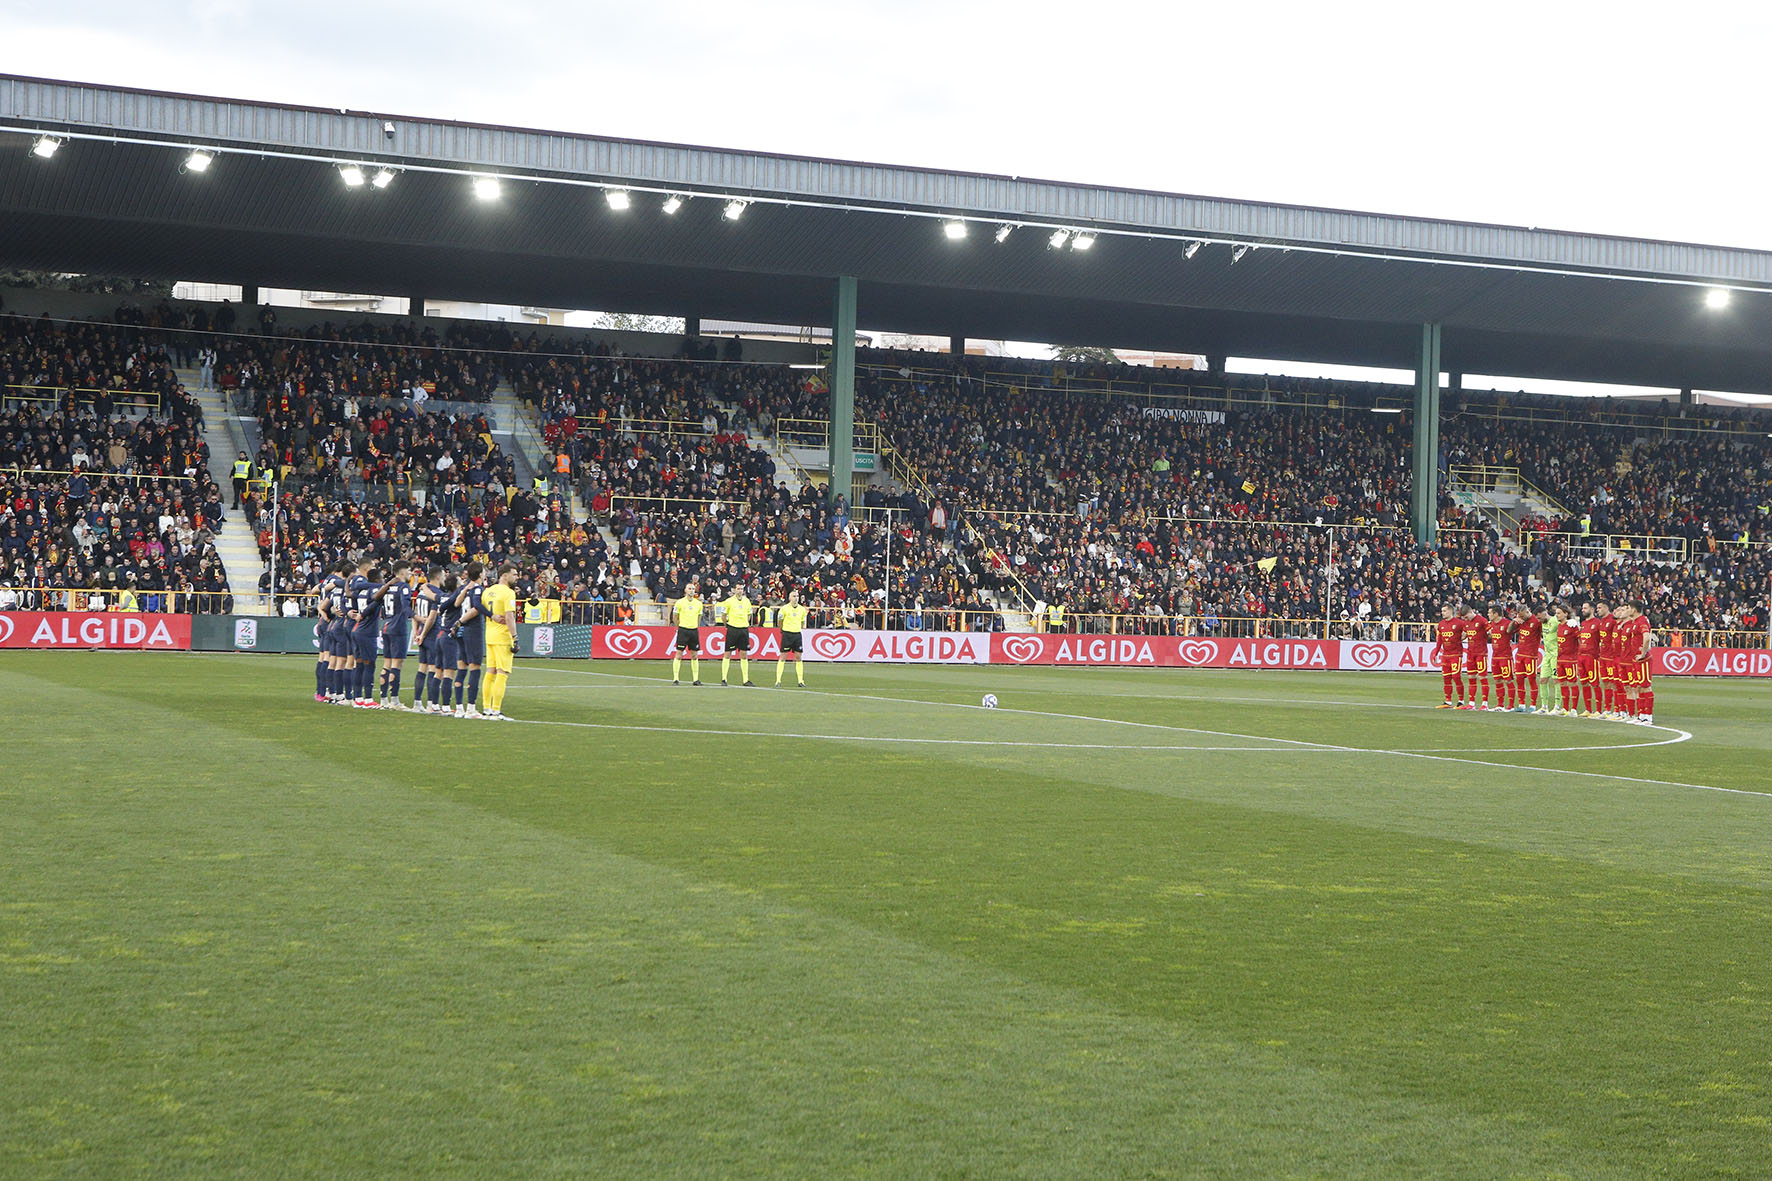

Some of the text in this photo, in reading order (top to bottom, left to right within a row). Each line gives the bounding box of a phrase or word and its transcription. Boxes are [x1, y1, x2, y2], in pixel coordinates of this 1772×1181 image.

[383, 593, 394, 616] 15
[30, 616, 174, 645] ALGIDA
[868, 635, 976, 660] ALGIDA
[1055, 638, 1155, 663] ALGIDA
[1229, 642, 1327, 666] ALGIDA
[1704, 652, 1772, 674] ALGID
